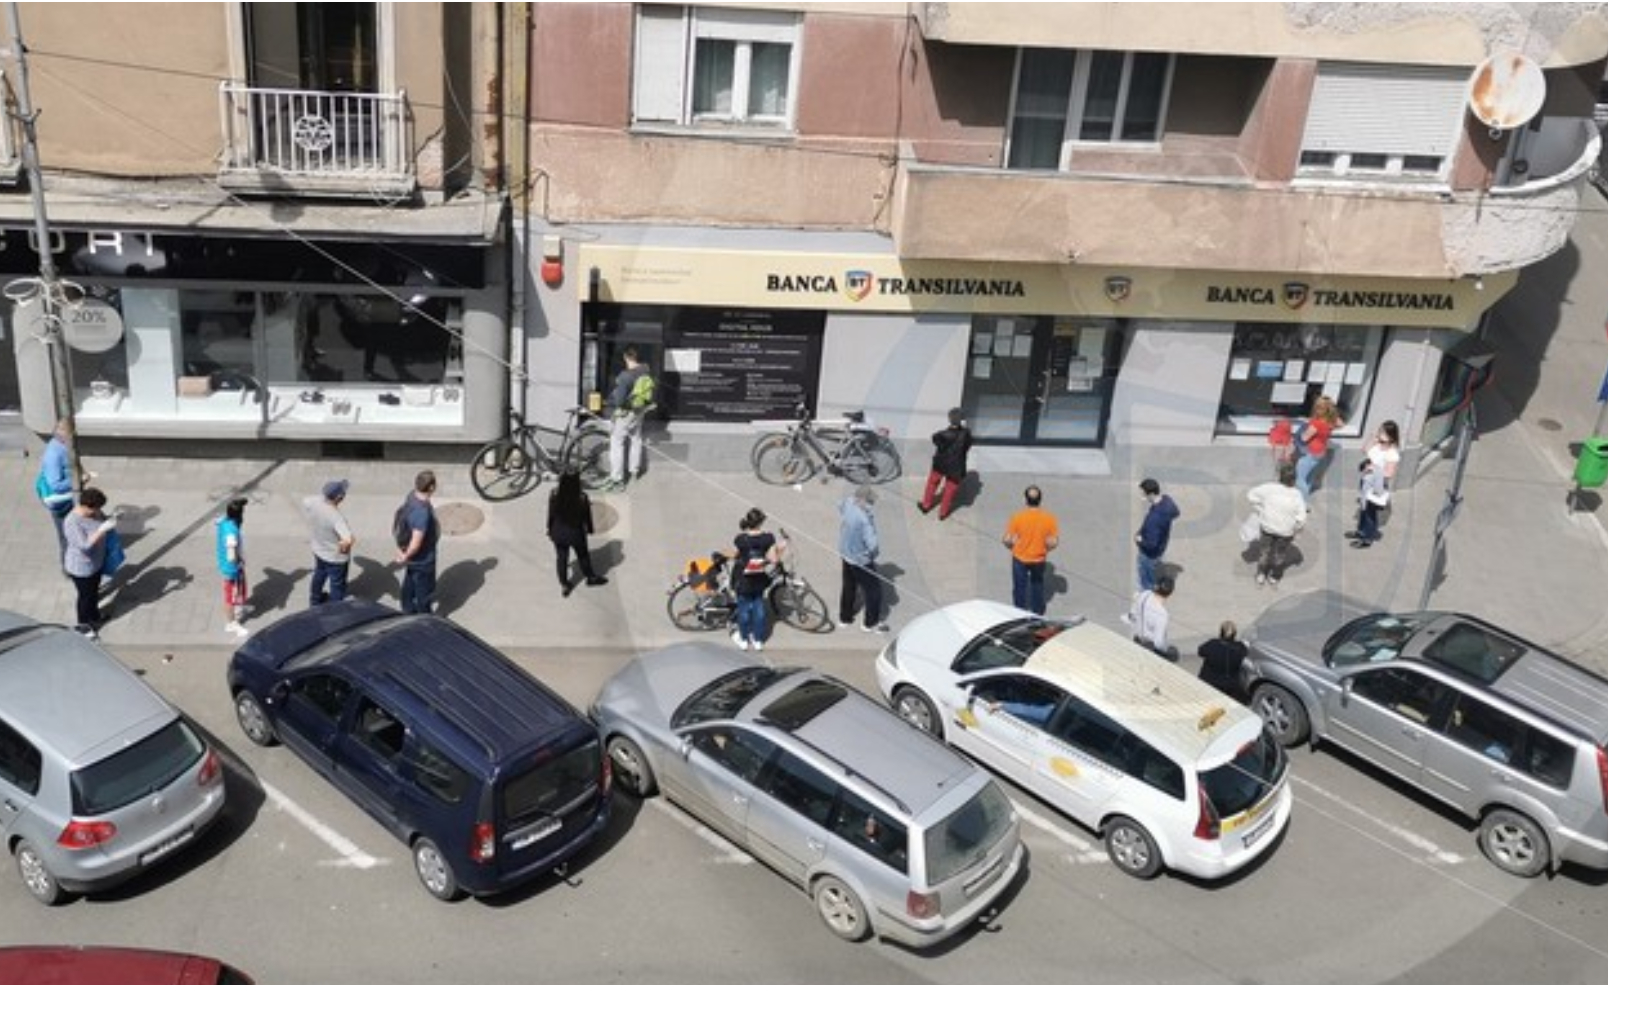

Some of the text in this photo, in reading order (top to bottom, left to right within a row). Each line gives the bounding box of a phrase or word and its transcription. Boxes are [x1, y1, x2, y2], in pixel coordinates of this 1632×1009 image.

[767, 274, 1026, 297] BANCA BT TRANSILVANIA
[1206, 286, 1275, 305] BANCA
[1313, 290, 1454, 310] TRANSILVANIA
[72, 310, 107, 323] 20%
